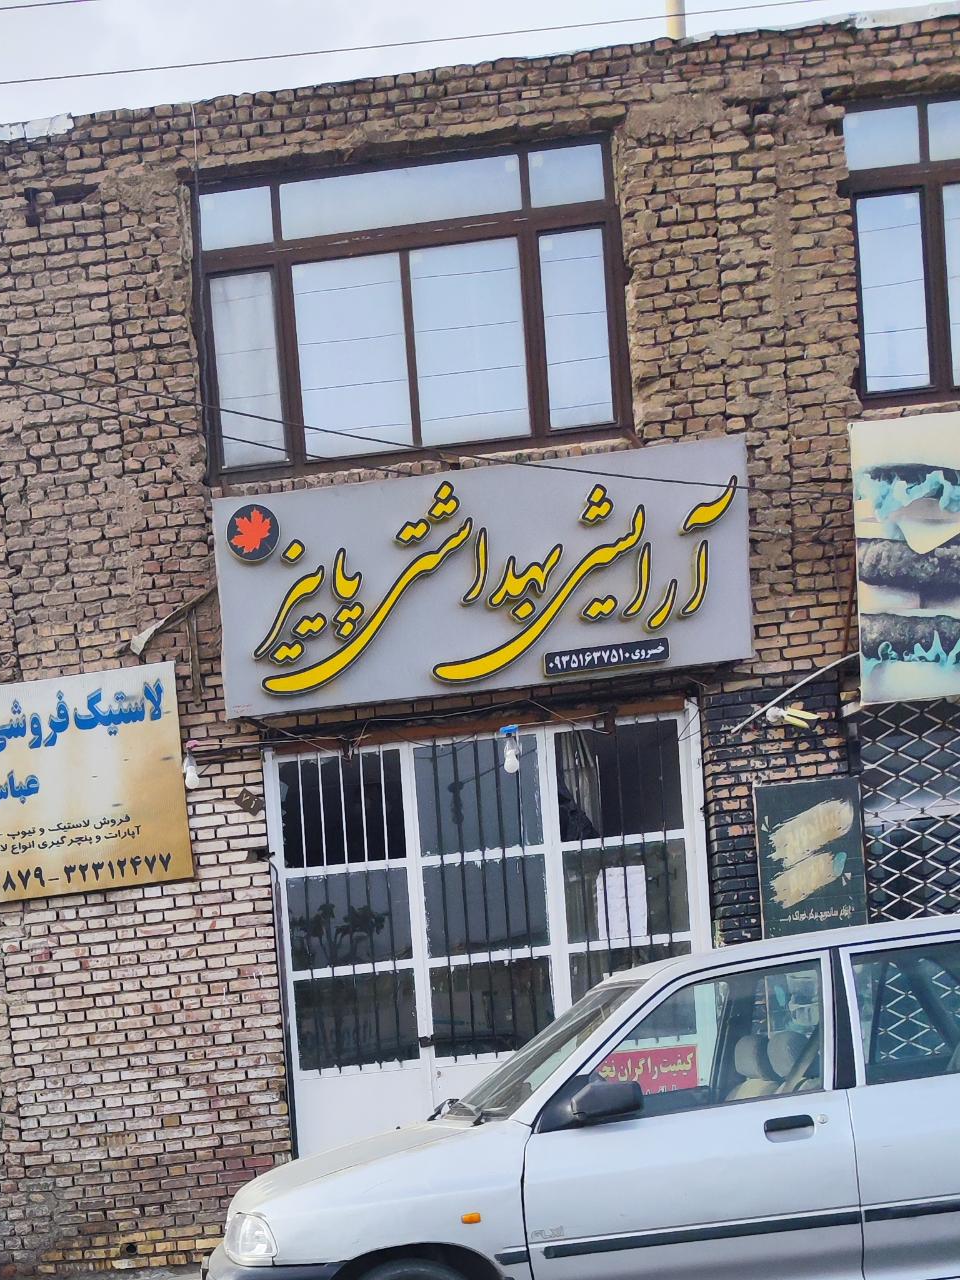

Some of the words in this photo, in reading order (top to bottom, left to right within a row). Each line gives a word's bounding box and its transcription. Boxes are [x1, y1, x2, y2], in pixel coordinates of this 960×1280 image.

[261, 480, 564, 696] بهداشتی
[432, 475, 738, 685] آرایشی
[253, 538, 364, 665] پاییز
[548, 647, 630, 670] ۰۹۳۵۱۶۳۷۵۱۰
[630, 642, 665, 661] خسروی
[74, 677, 165, 737] لاستیک
[38, 826, 46, 837] و
[47, 818, 91, 834] لاستیک
[93, 813, 132, 831] فروش
[104, 824, 142, 840] آپارات
[10, 841, 36, 855] انواع
[94, 834, 102, 844] و
[617, 1057, 646, 1082] گران
[647, 1055, 659, 1080] را
[659, 1051, 695, 1077] کیفیت
